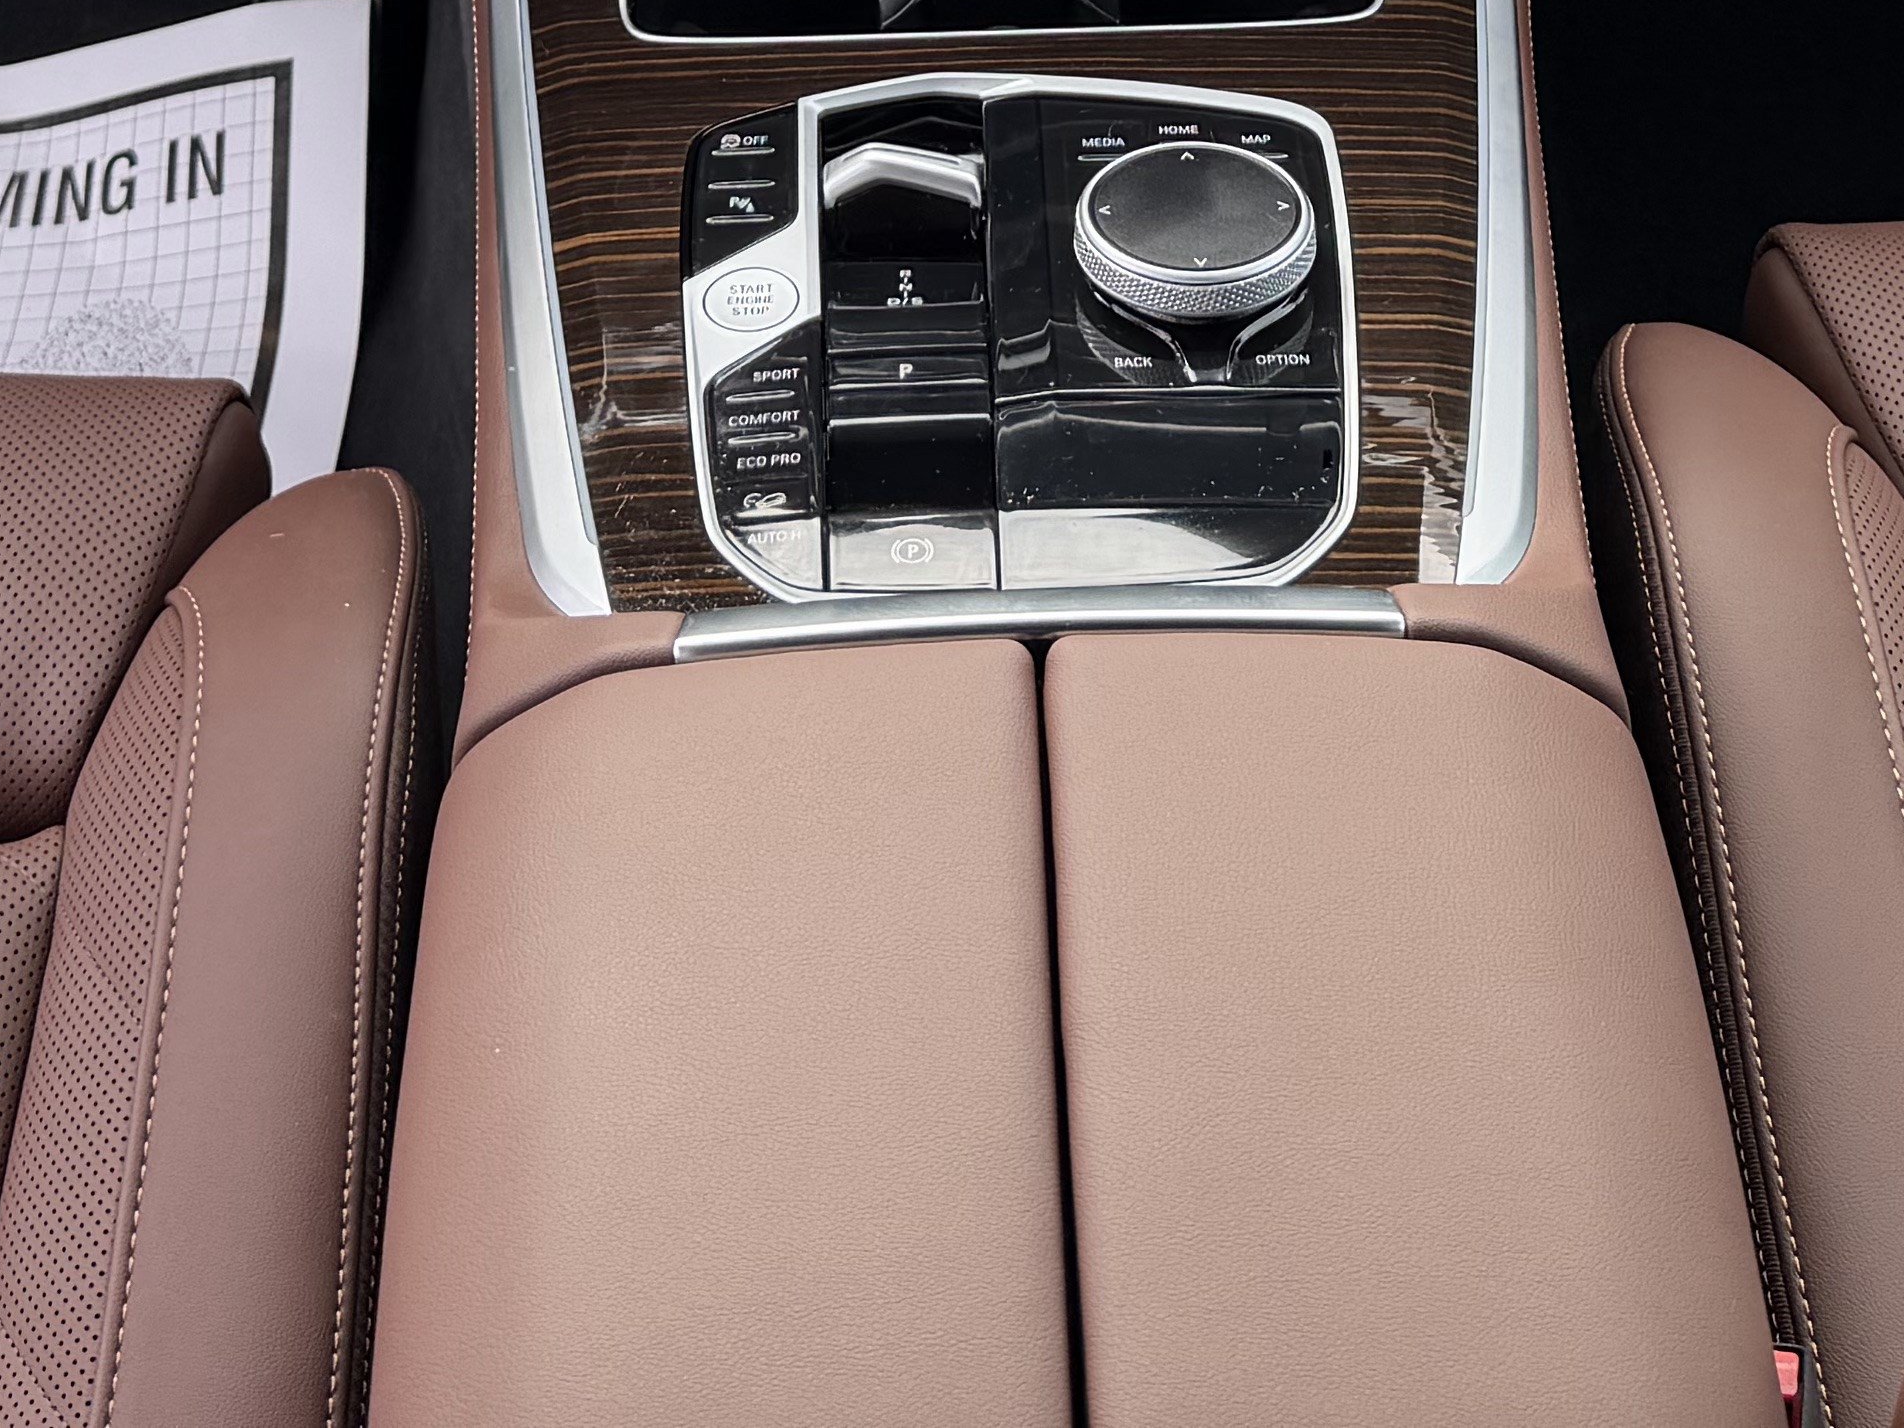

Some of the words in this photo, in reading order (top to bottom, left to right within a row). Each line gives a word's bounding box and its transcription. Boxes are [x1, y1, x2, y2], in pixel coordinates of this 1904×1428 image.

[1158, 124, 1199, 136] HOME
[742, 134, 769, 146] OFF
[1081, 136, 1126, 148] MEDIA
[1241, 133, 1272, 145] MAP
[163, 129, 229, 209] IN
[729, 282, 774, 295] START
[726, 293, 774, 306] ENGINE
[731, 306, 770, 317] STOP
[1114, 354, 1153, 369] BACK
[1254, 352, 1311, 368] OPTION
[752, 367, 801, 382] SPORT
[898, 362, 914, 380] P
[727, 409, 801, 428] COMFORT
[736, 453, 767, 470] ECO
[770, 452, 802, 467] PRO
[746, 530, 787, 545] AUTO
